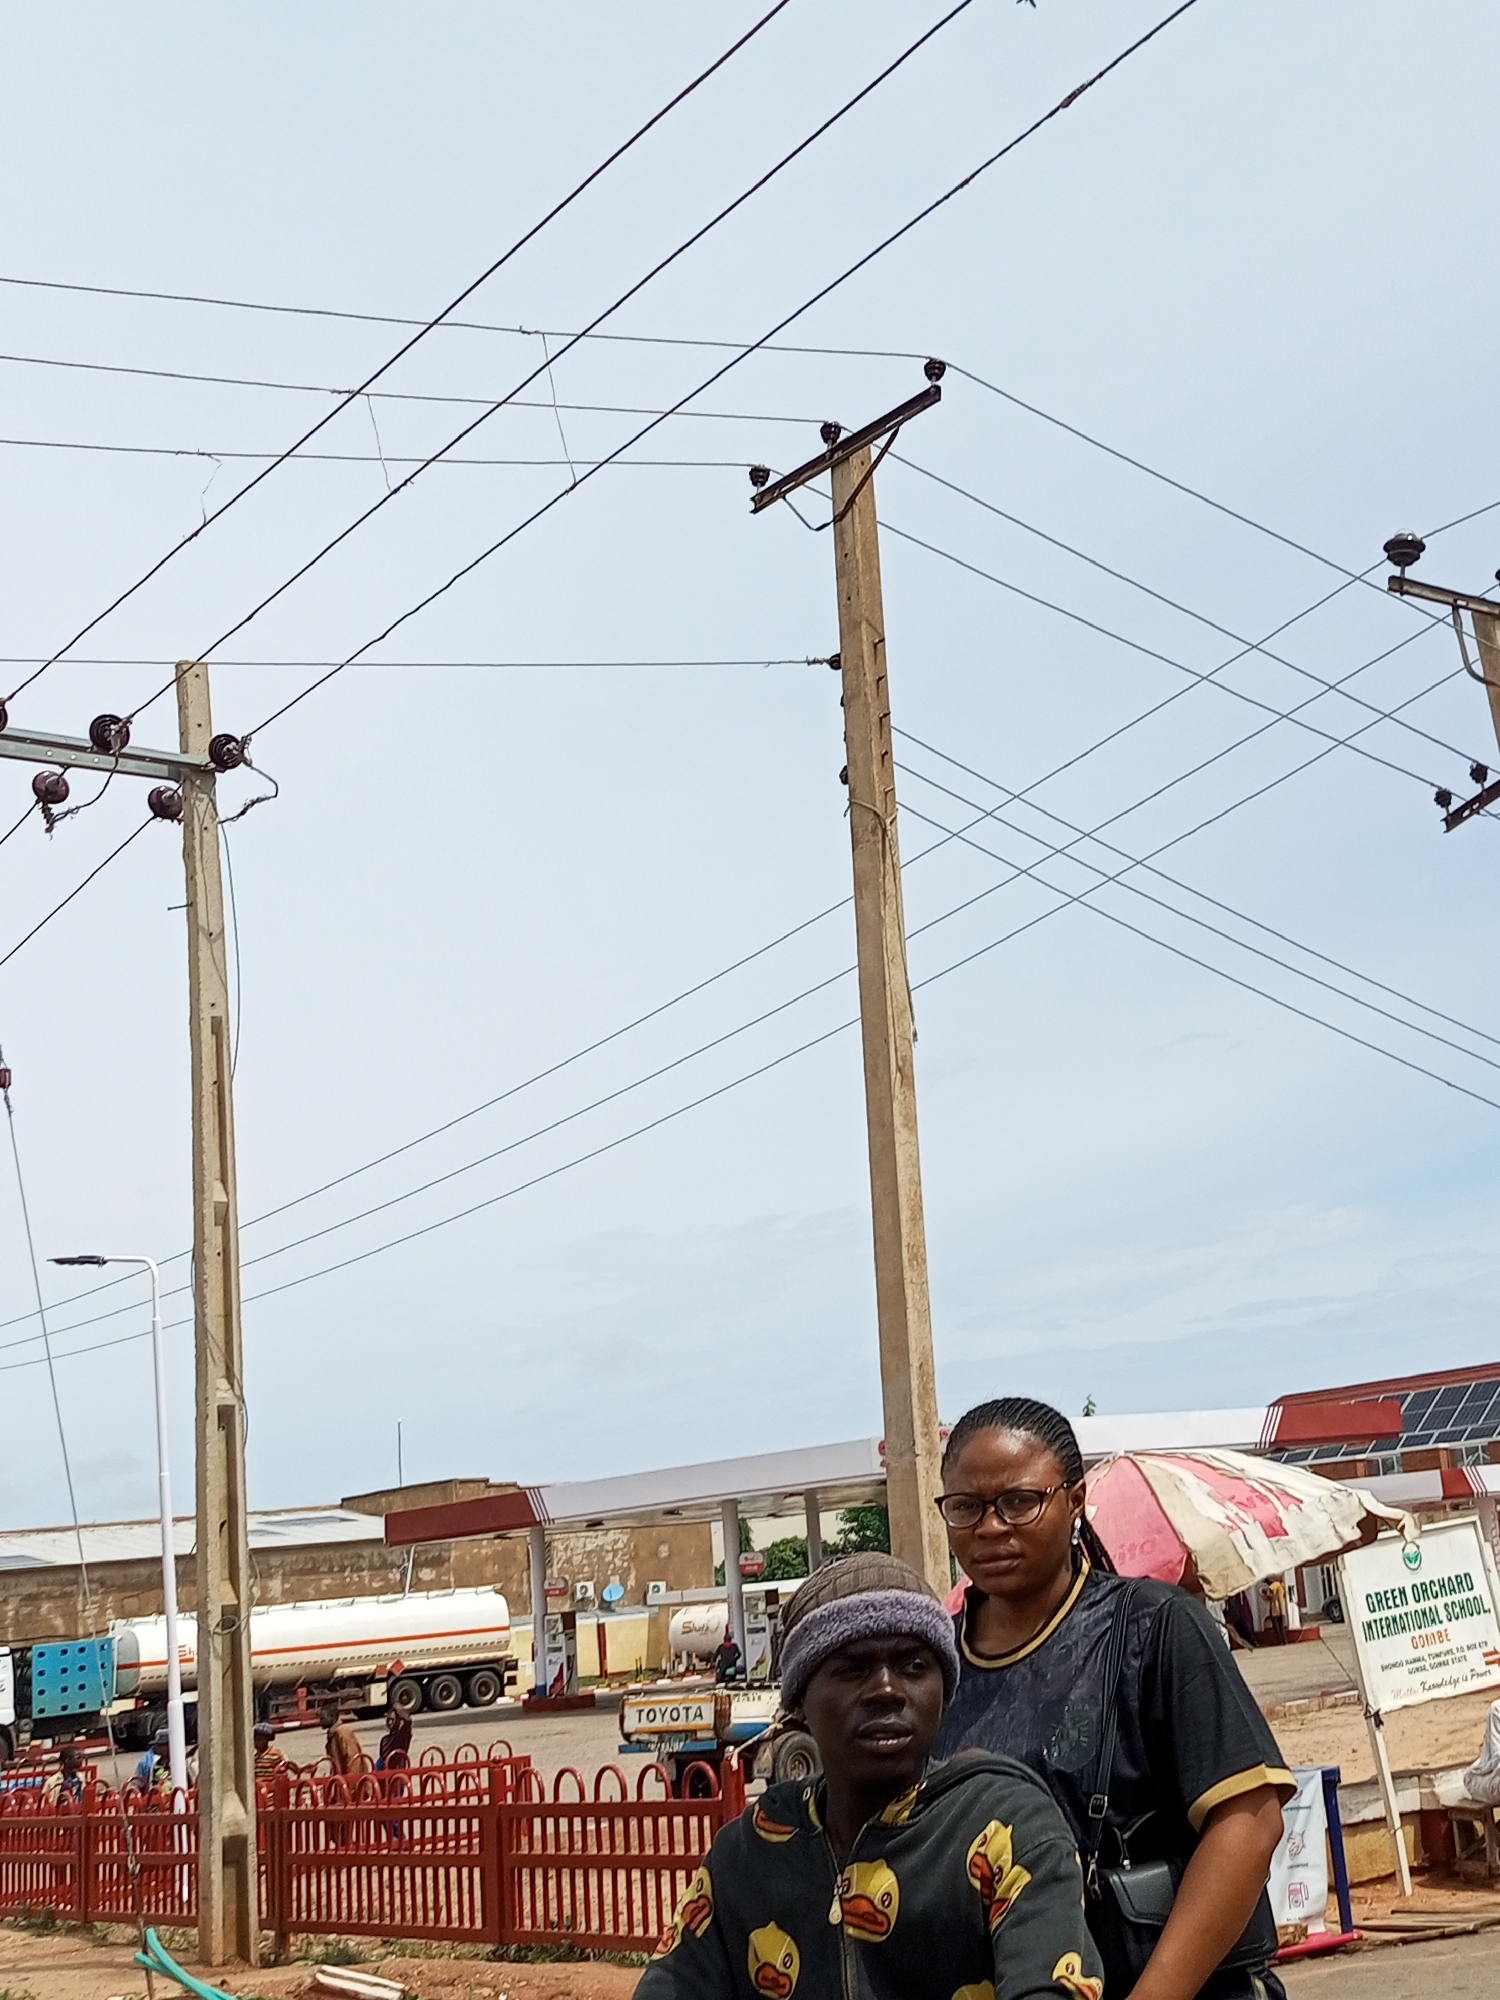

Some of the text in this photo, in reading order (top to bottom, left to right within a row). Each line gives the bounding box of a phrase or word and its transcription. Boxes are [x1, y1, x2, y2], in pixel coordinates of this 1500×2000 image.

[1365, 1571, 1475, 1614] GREEN ORCHARD
[1361, 1593, 1491, 1643] INTERNATIONAL SCHOOL,
[1411, 1628, 1451, 1650] GOMBE
[1420, 1675, 1460, 1692] Knowledge
[636, 1705, 704, 1724] TOYOTA
